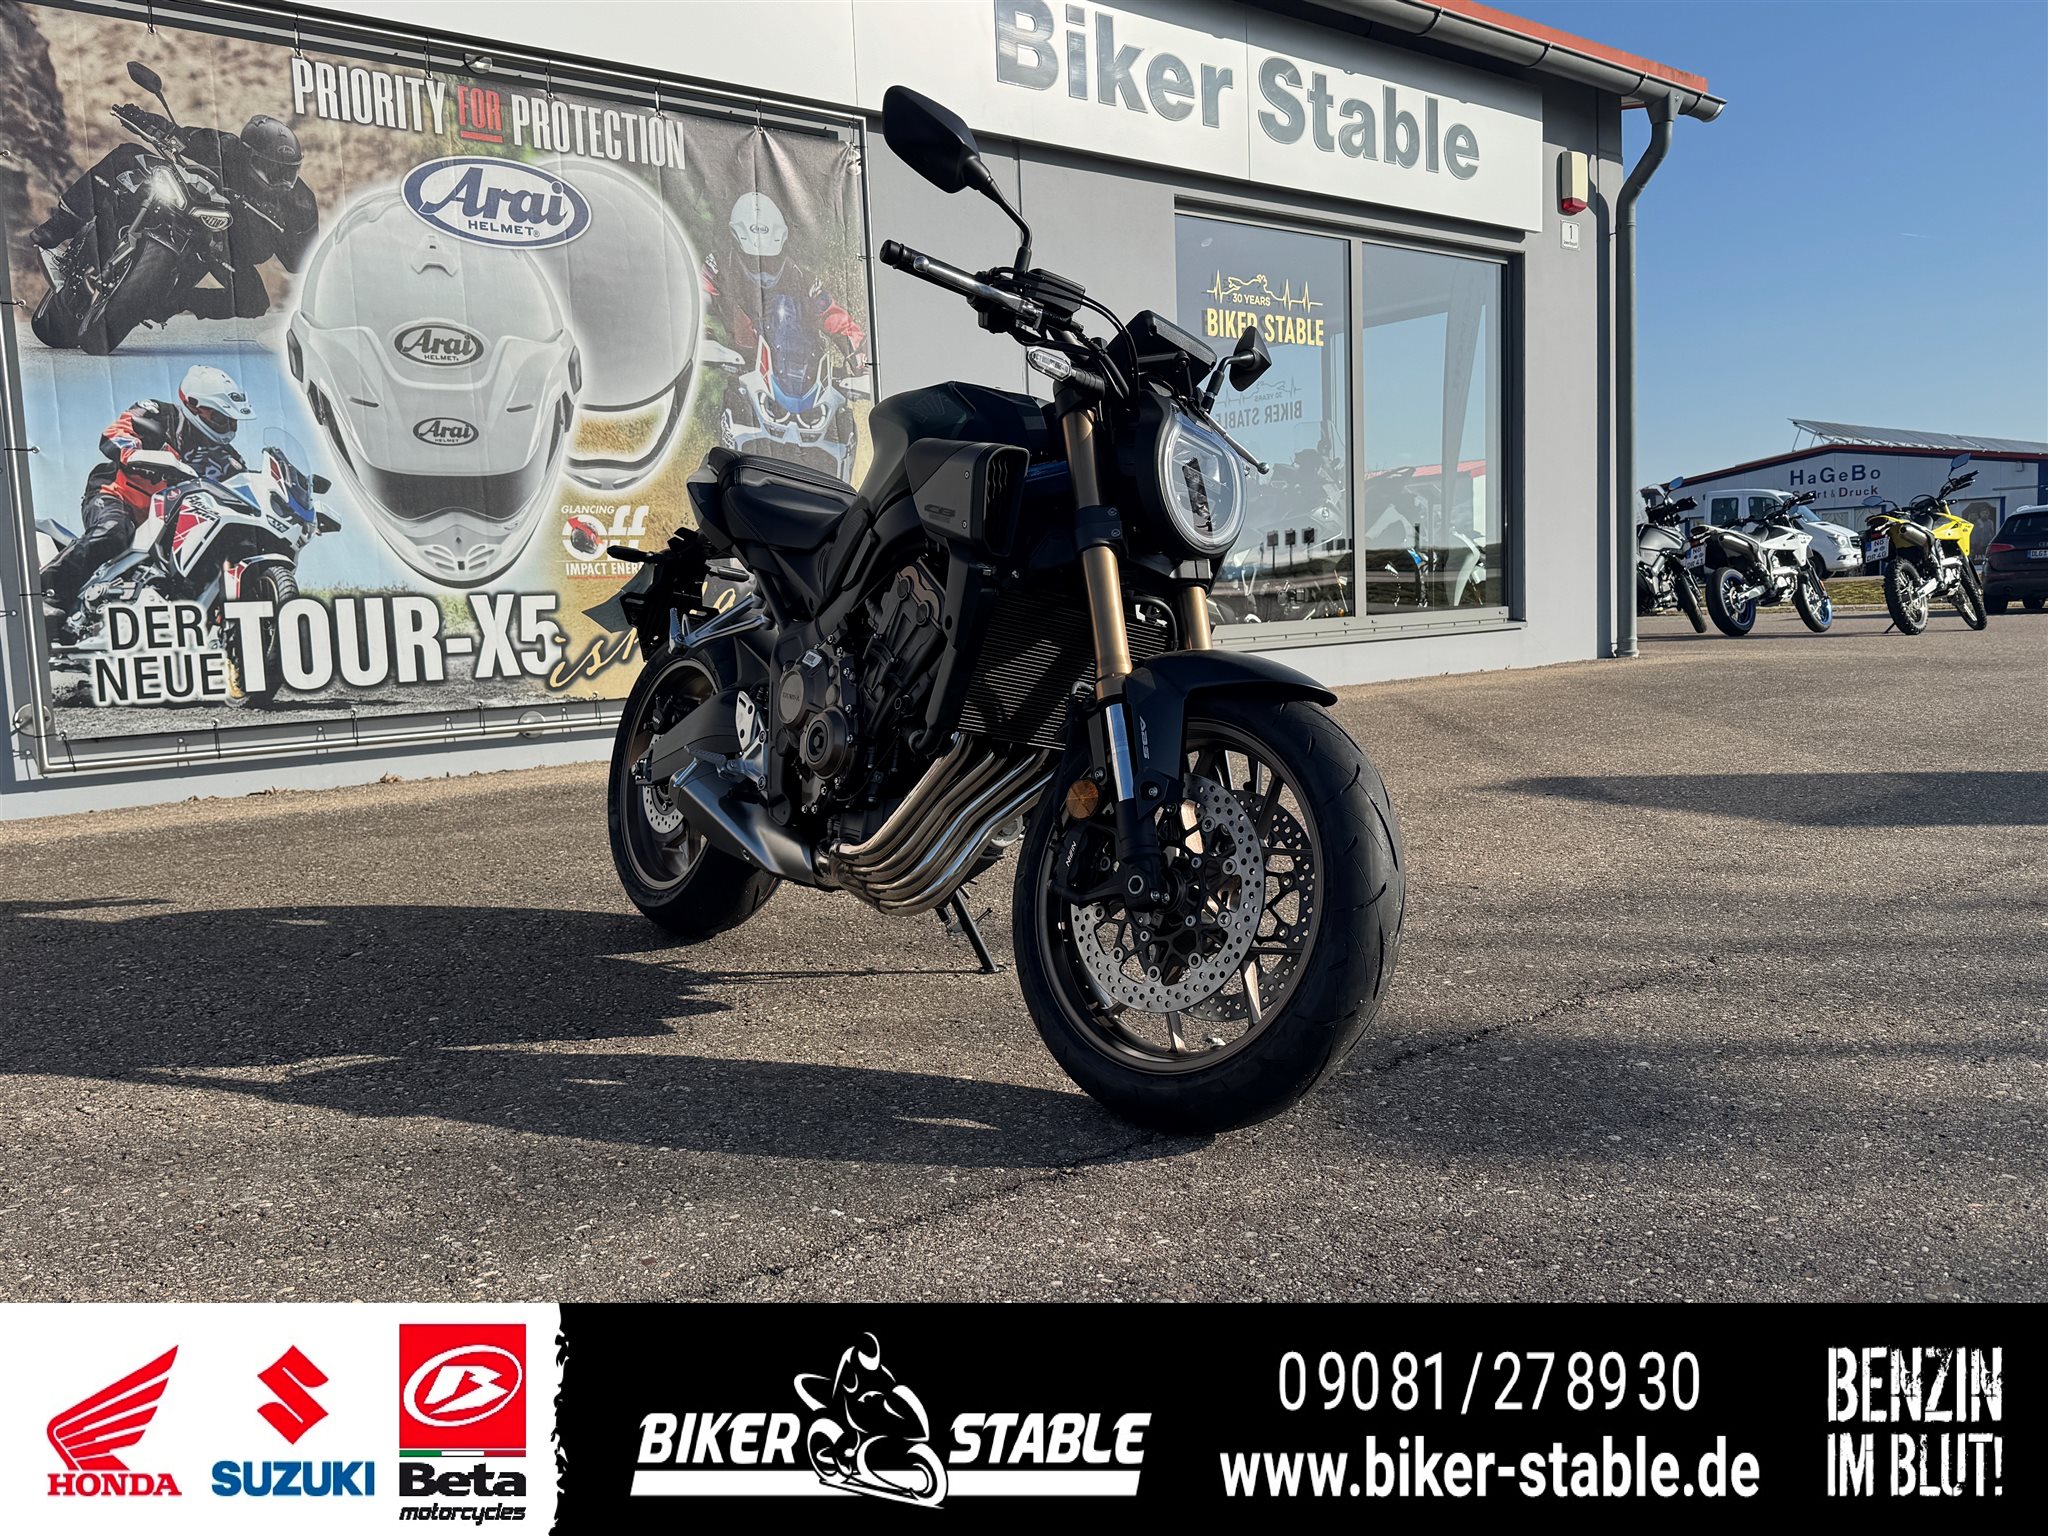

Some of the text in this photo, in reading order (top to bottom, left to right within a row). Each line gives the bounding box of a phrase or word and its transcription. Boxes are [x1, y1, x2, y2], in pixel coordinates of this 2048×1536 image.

[996, 0, 1480, 180] Biker Stable
[292, 57, 687, 170] PRIORITY FOR PROTECTION
[420, 166, 568, 226] Arai
[468, 219, 535, 237] HELMET
[1569, 225, 1573, 240] 1
[1232, 293, 1271, 307] 30 YEARS
[1264, 314, 1325, 347] STABLE
[401, 329, 474, 356] Arai
[424, 354, 458, 362] HELMET
[419, 420, 472, 439] Arai
[1790, 464, 1881, 486] HaGeBo
[1838, 484, 1879, 498] Druck
[561, 505, 616, 514] GLANCING
[565, 562, 645, 576] IMPACT ENER
[108, 604, 205, 651] DER
[223, 593, 562, 693] TOUR-X5
[94, 652, 227, 703] NEUE
